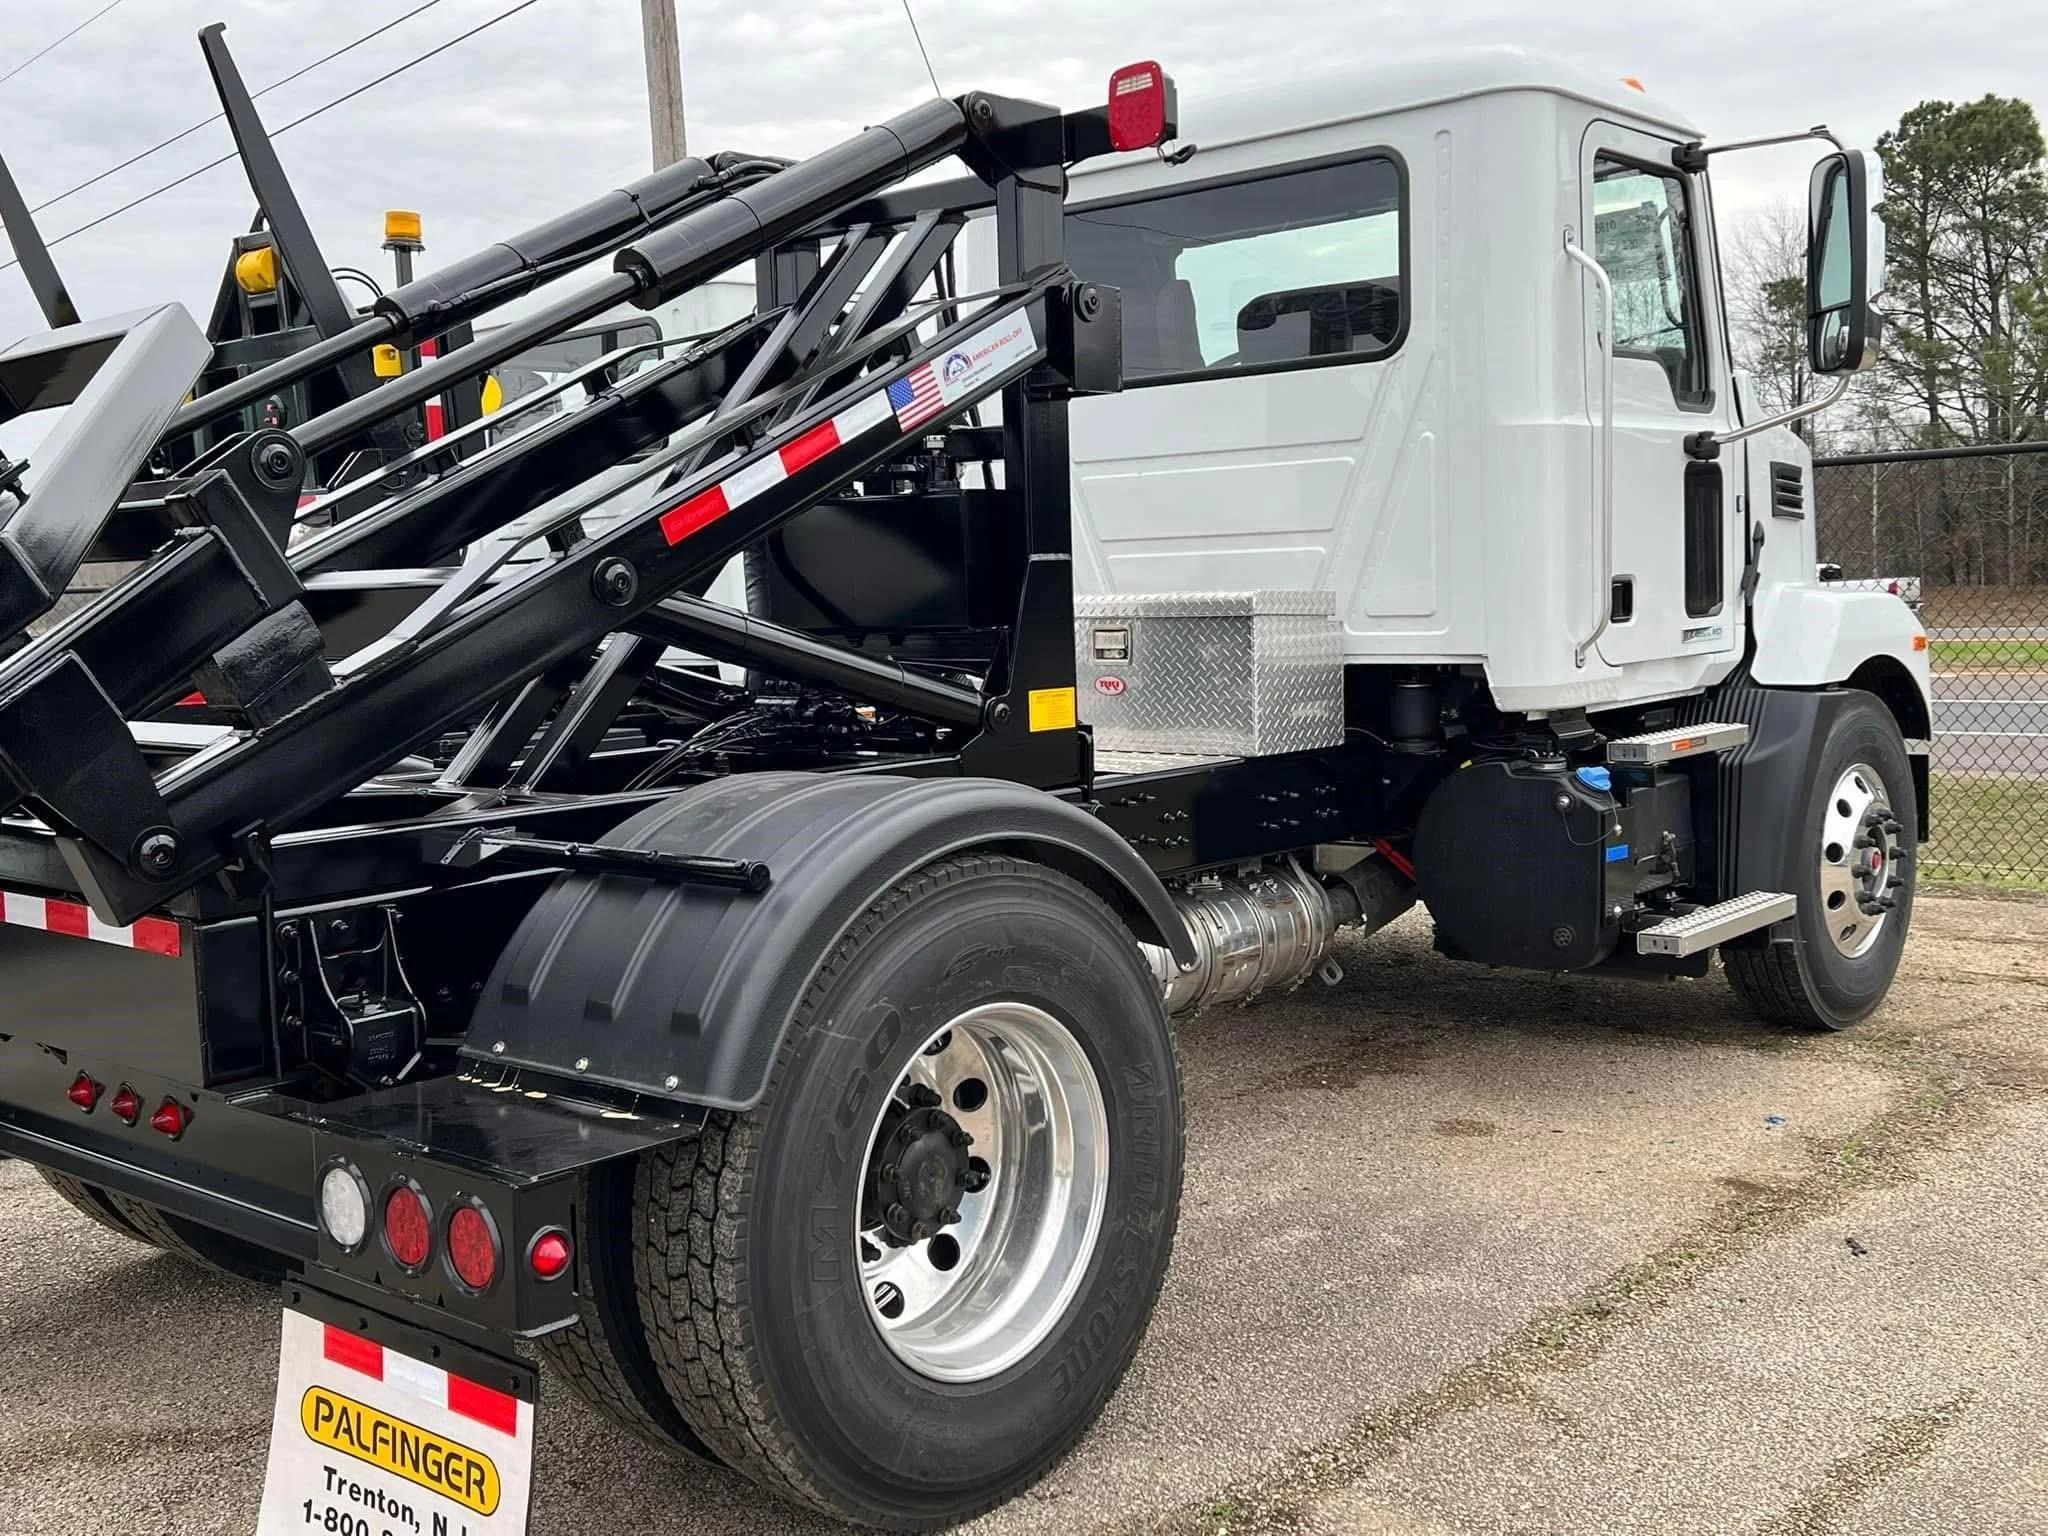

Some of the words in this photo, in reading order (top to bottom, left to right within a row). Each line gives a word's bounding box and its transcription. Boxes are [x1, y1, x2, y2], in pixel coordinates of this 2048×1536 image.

[973, 342, 1000, 362] AMERICAN
[313, 1395, 486, 1505] PALFINGER
[323, 1465, 420, 1533] Trenton,
